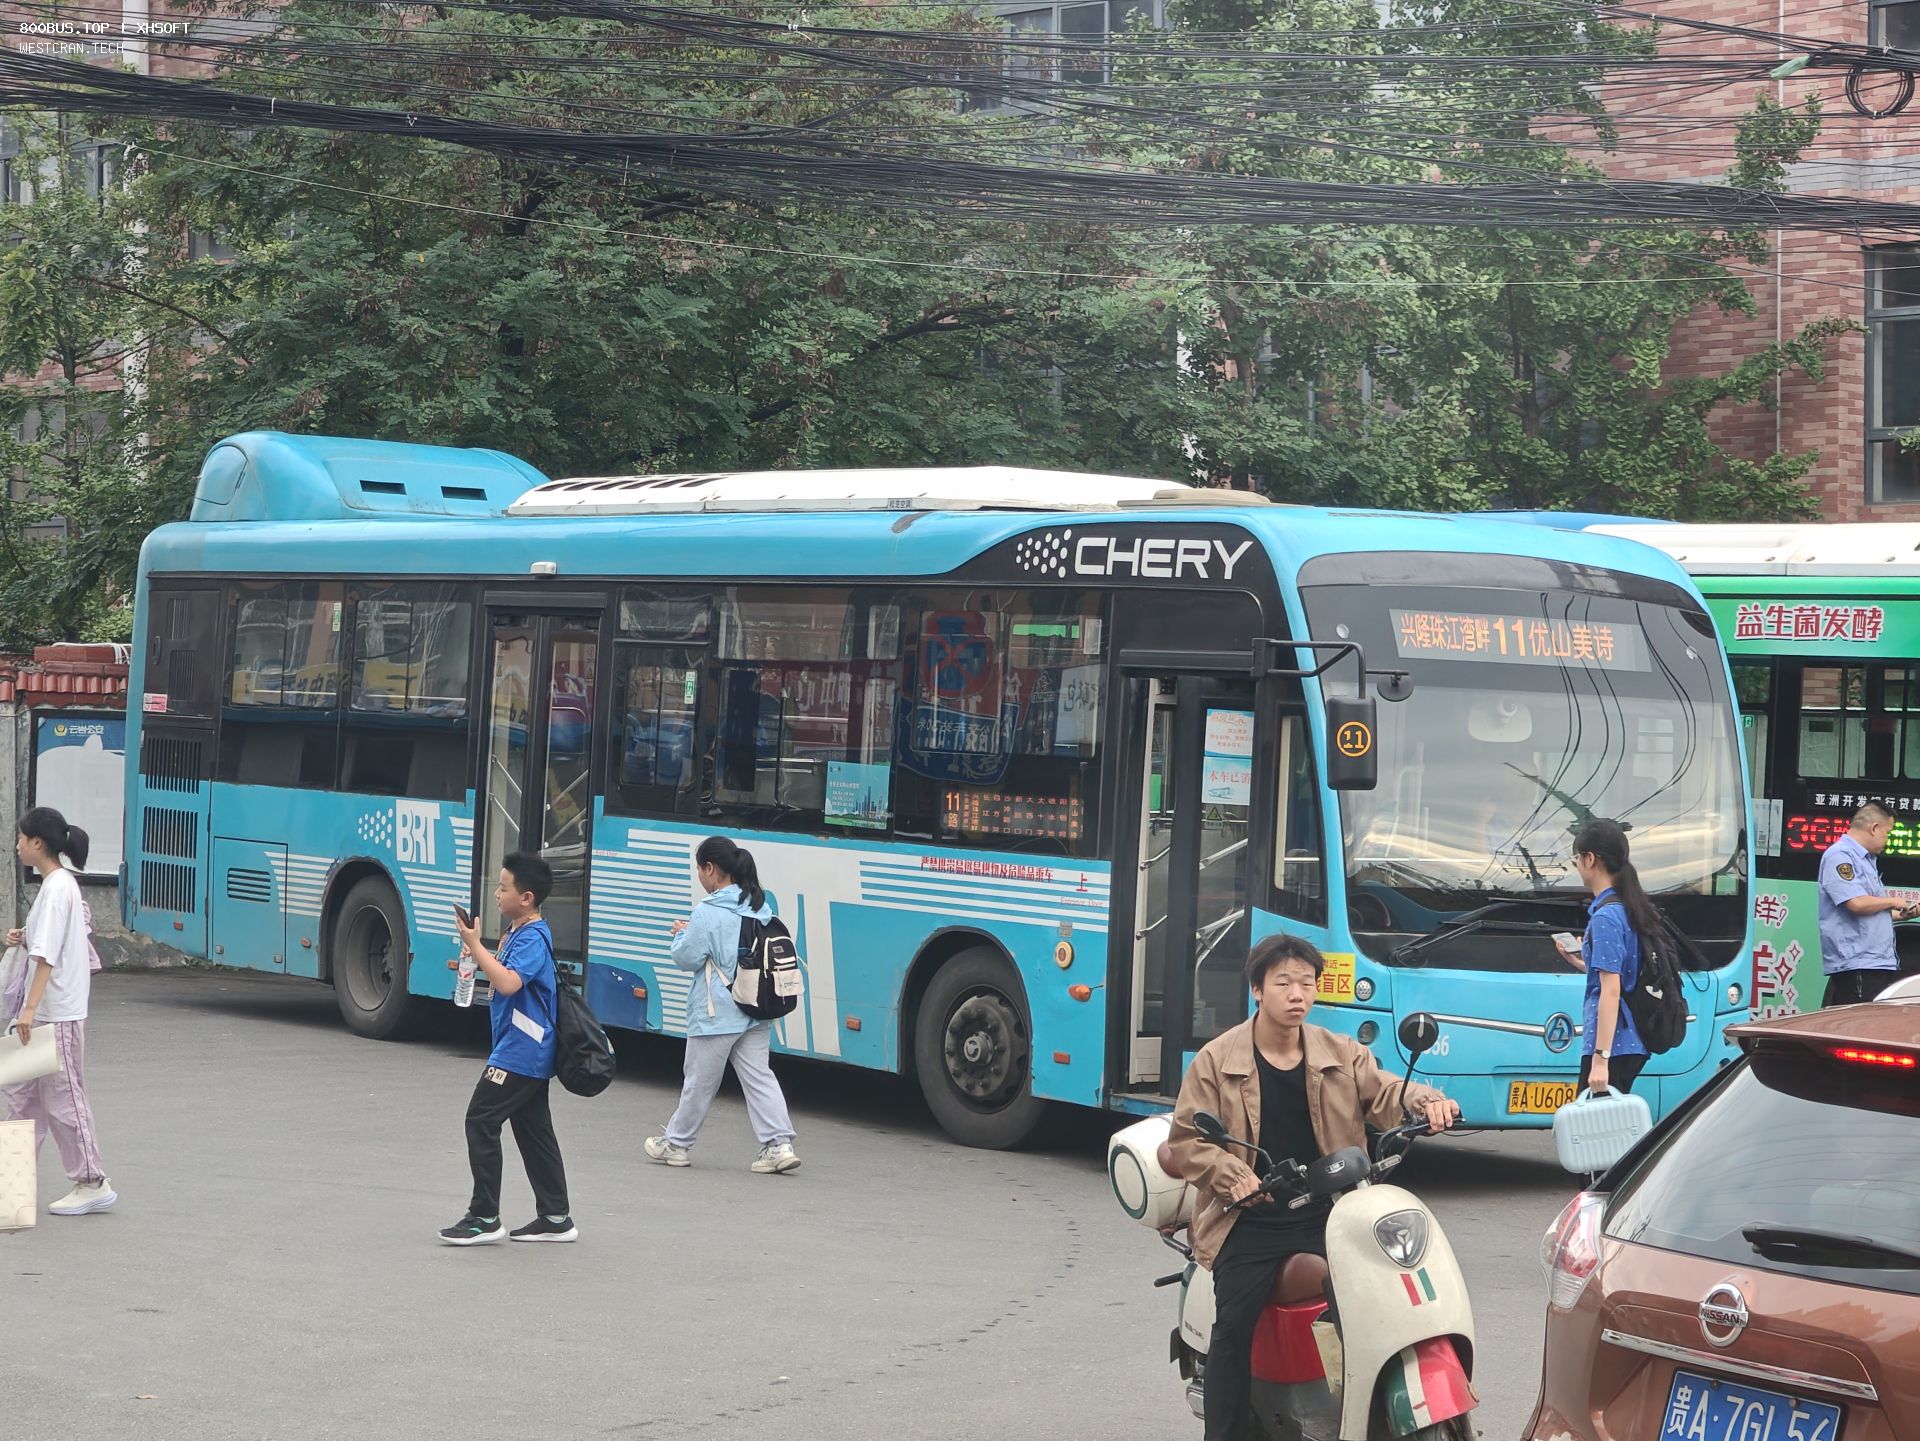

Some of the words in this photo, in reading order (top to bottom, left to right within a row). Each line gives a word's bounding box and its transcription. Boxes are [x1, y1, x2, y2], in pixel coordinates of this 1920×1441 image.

[1075, 537, 1254, 580] CHERY
[1735, 604, 1884, 640] 益生菌发酵
[1400, 613, 1492, 653] 兴隆珠江湾畔
[1493, 617, 1527, 657] 11
[1529, 620, 1615, 662] 优山美诗
[1343, 730, 1365, 749] 11
[946, 791, 961, 811] 11
[395, 799, 440, 865] BRT
[1076, 872, 1088, 892] 上
[1511, 1086, 1574, 1109] 贵A·U608
[1700, 1308, 1741, 1324] NISSAN
